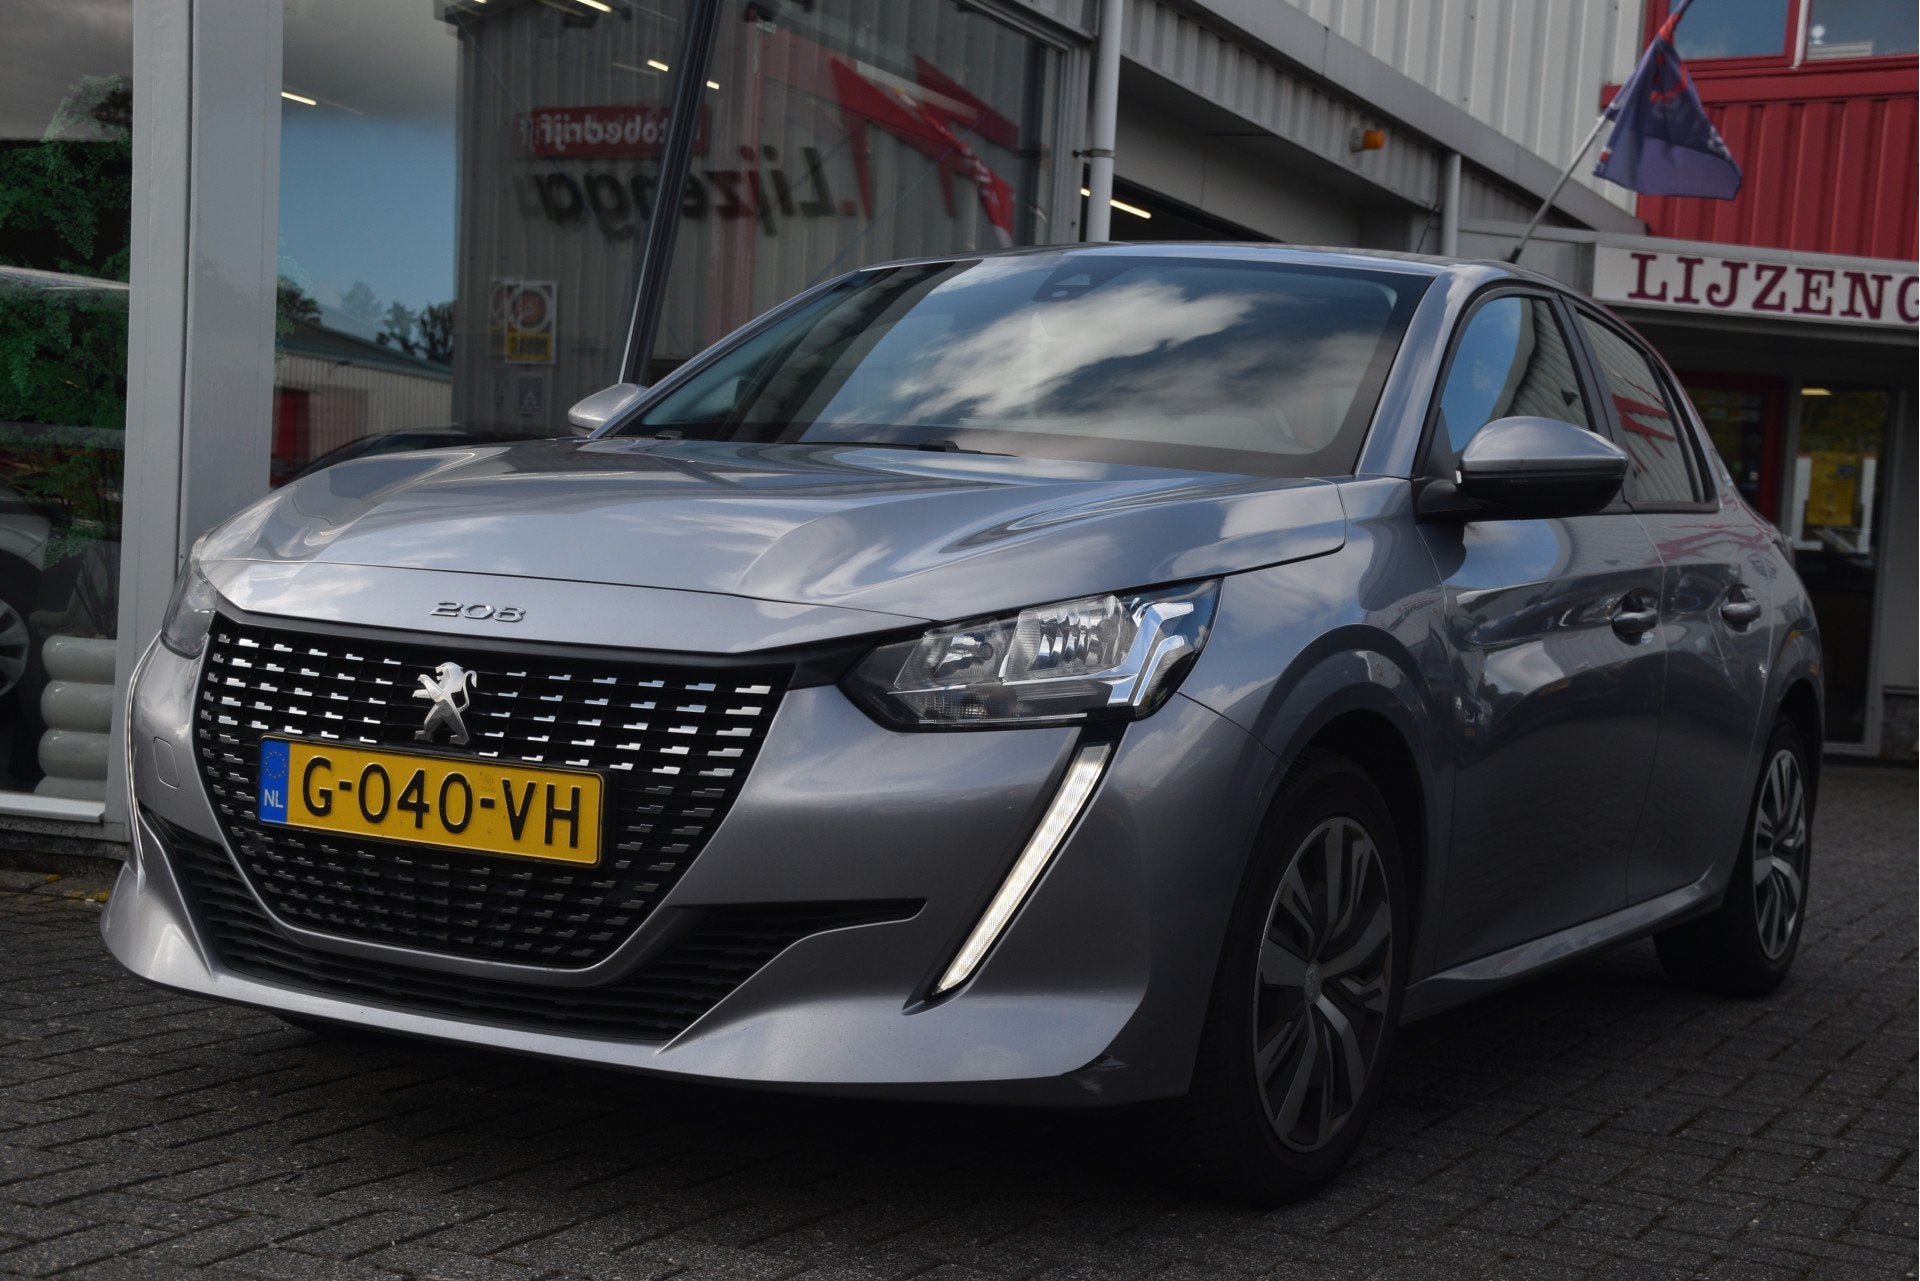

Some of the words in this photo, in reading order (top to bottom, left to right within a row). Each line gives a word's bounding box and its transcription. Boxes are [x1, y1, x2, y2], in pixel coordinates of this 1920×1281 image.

[430, 602, 526, 622] 208
[264, 789, 283, 809] NL
[302, 756, 581, 848] G-040-VH
